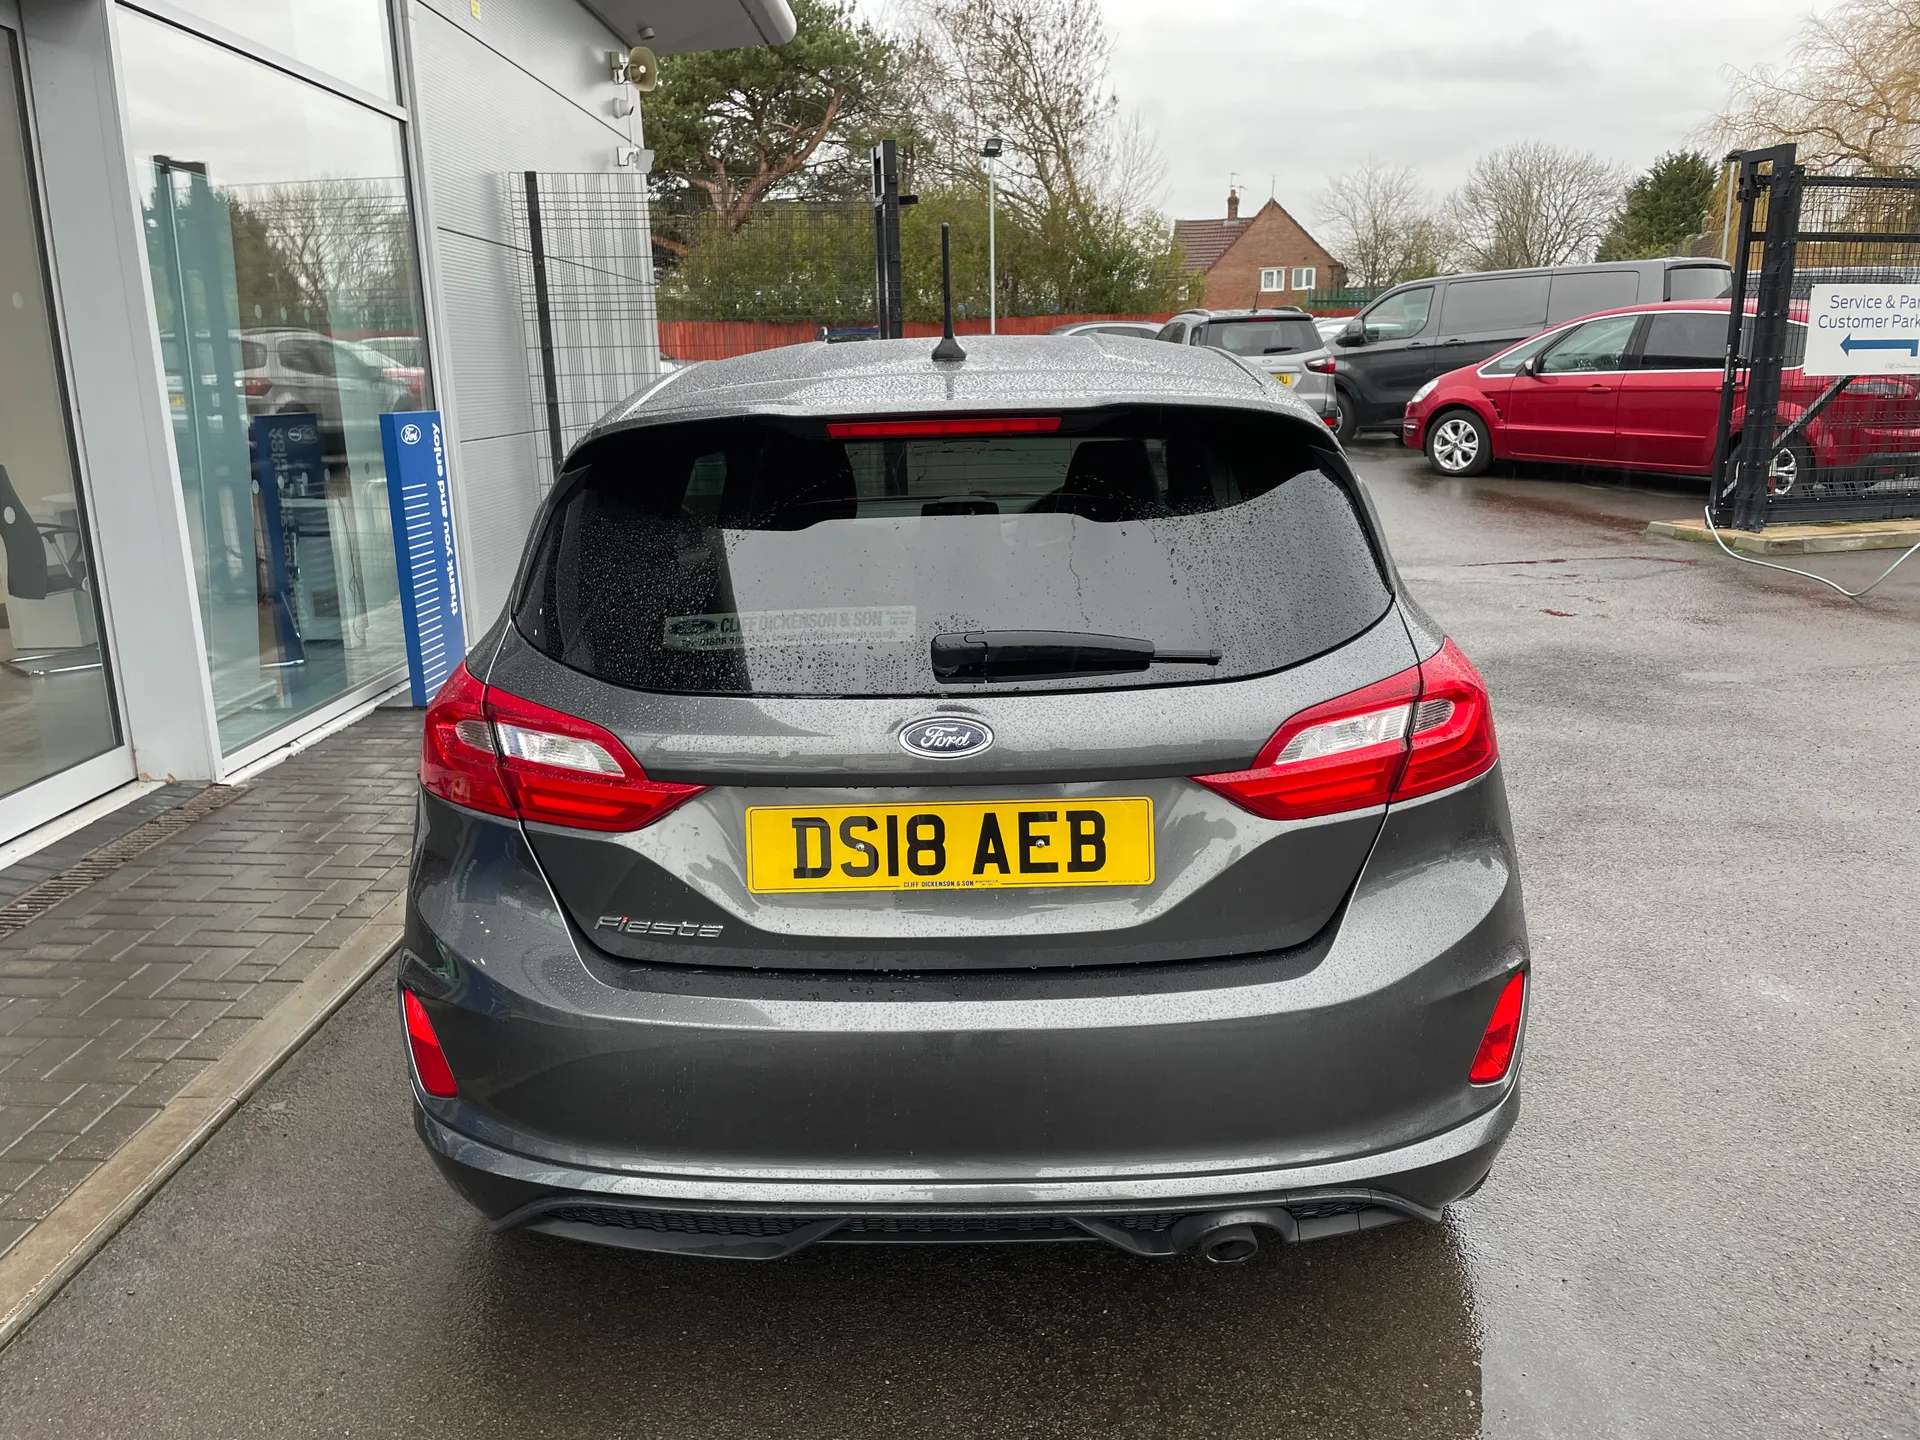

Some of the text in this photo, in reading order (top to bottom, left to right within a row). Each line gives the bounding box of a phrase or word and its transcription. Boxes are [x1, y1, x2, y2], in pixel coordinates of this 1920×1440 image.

[1830, 294, 1882, 309] Service
[1886, 294, 1896, 309] &
[1818, 314, 1889, 329] Customer
[432, 422, 458, 616] thank you and enjoy
[920, 726, 971, 748] Ford
[791, 809, 1107, 879] DS18 AEB
[593, 916, 724, 938] Fiesta
